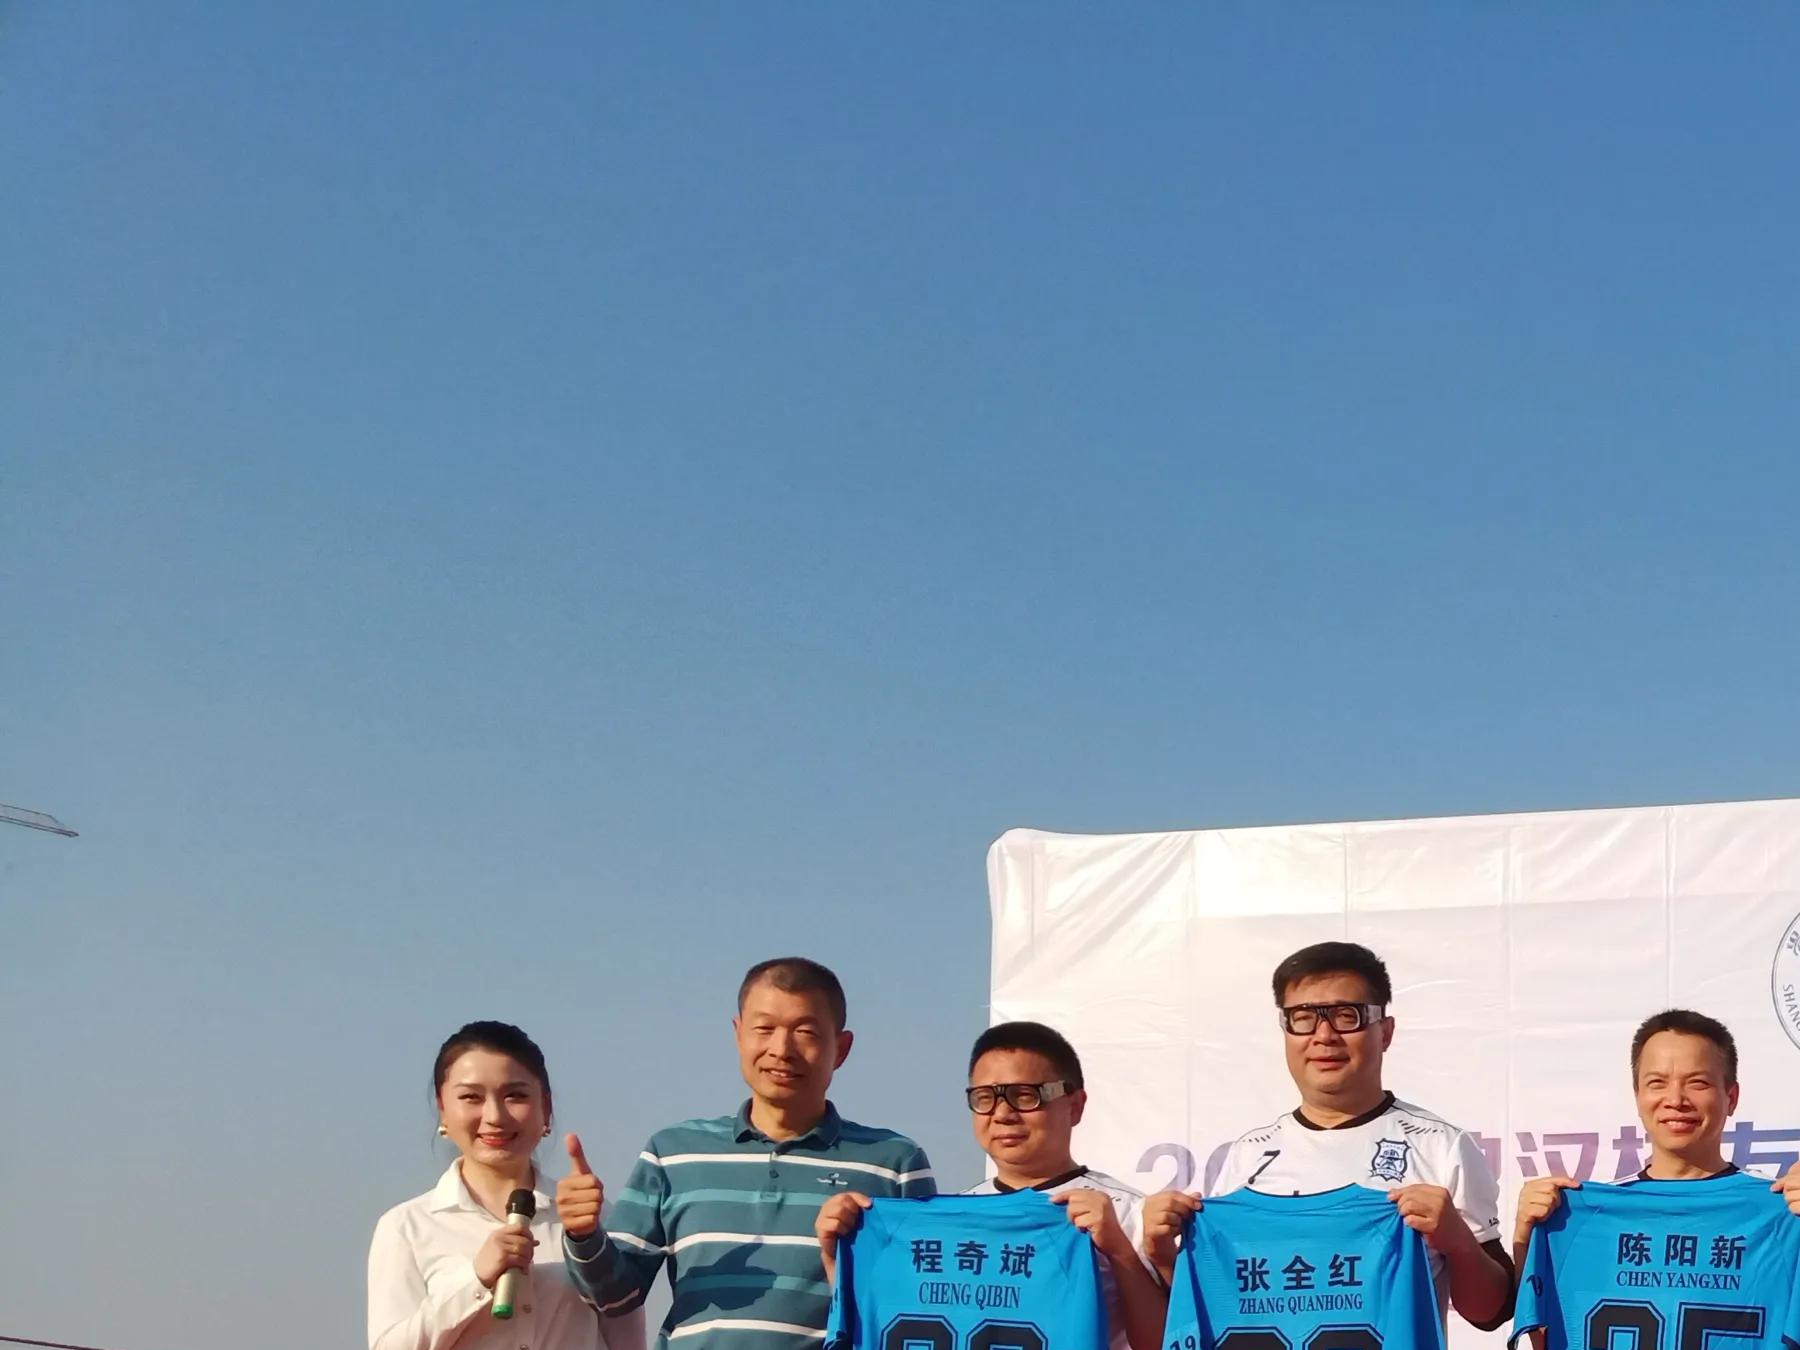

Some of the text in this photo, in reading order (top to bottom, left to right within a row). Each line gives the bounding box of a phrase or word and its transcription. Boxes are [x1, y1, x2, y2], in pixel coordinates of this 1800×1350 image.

[1248, 1150, 1281, 1184] 7
[911, 1239, 1036, 1279] 程奇斌
[1617, 1232, 1747, 1270] 陈阳新
[1235, 1253, 1363, 1293] 张全红
[1616, 1270, 1742, 1291] CHEN YANGXIN
[919, 1282, 1021, 1311] CHENG QIBIN
[1240, 1293, 1363, 1315] ZHANG QUANHONG
